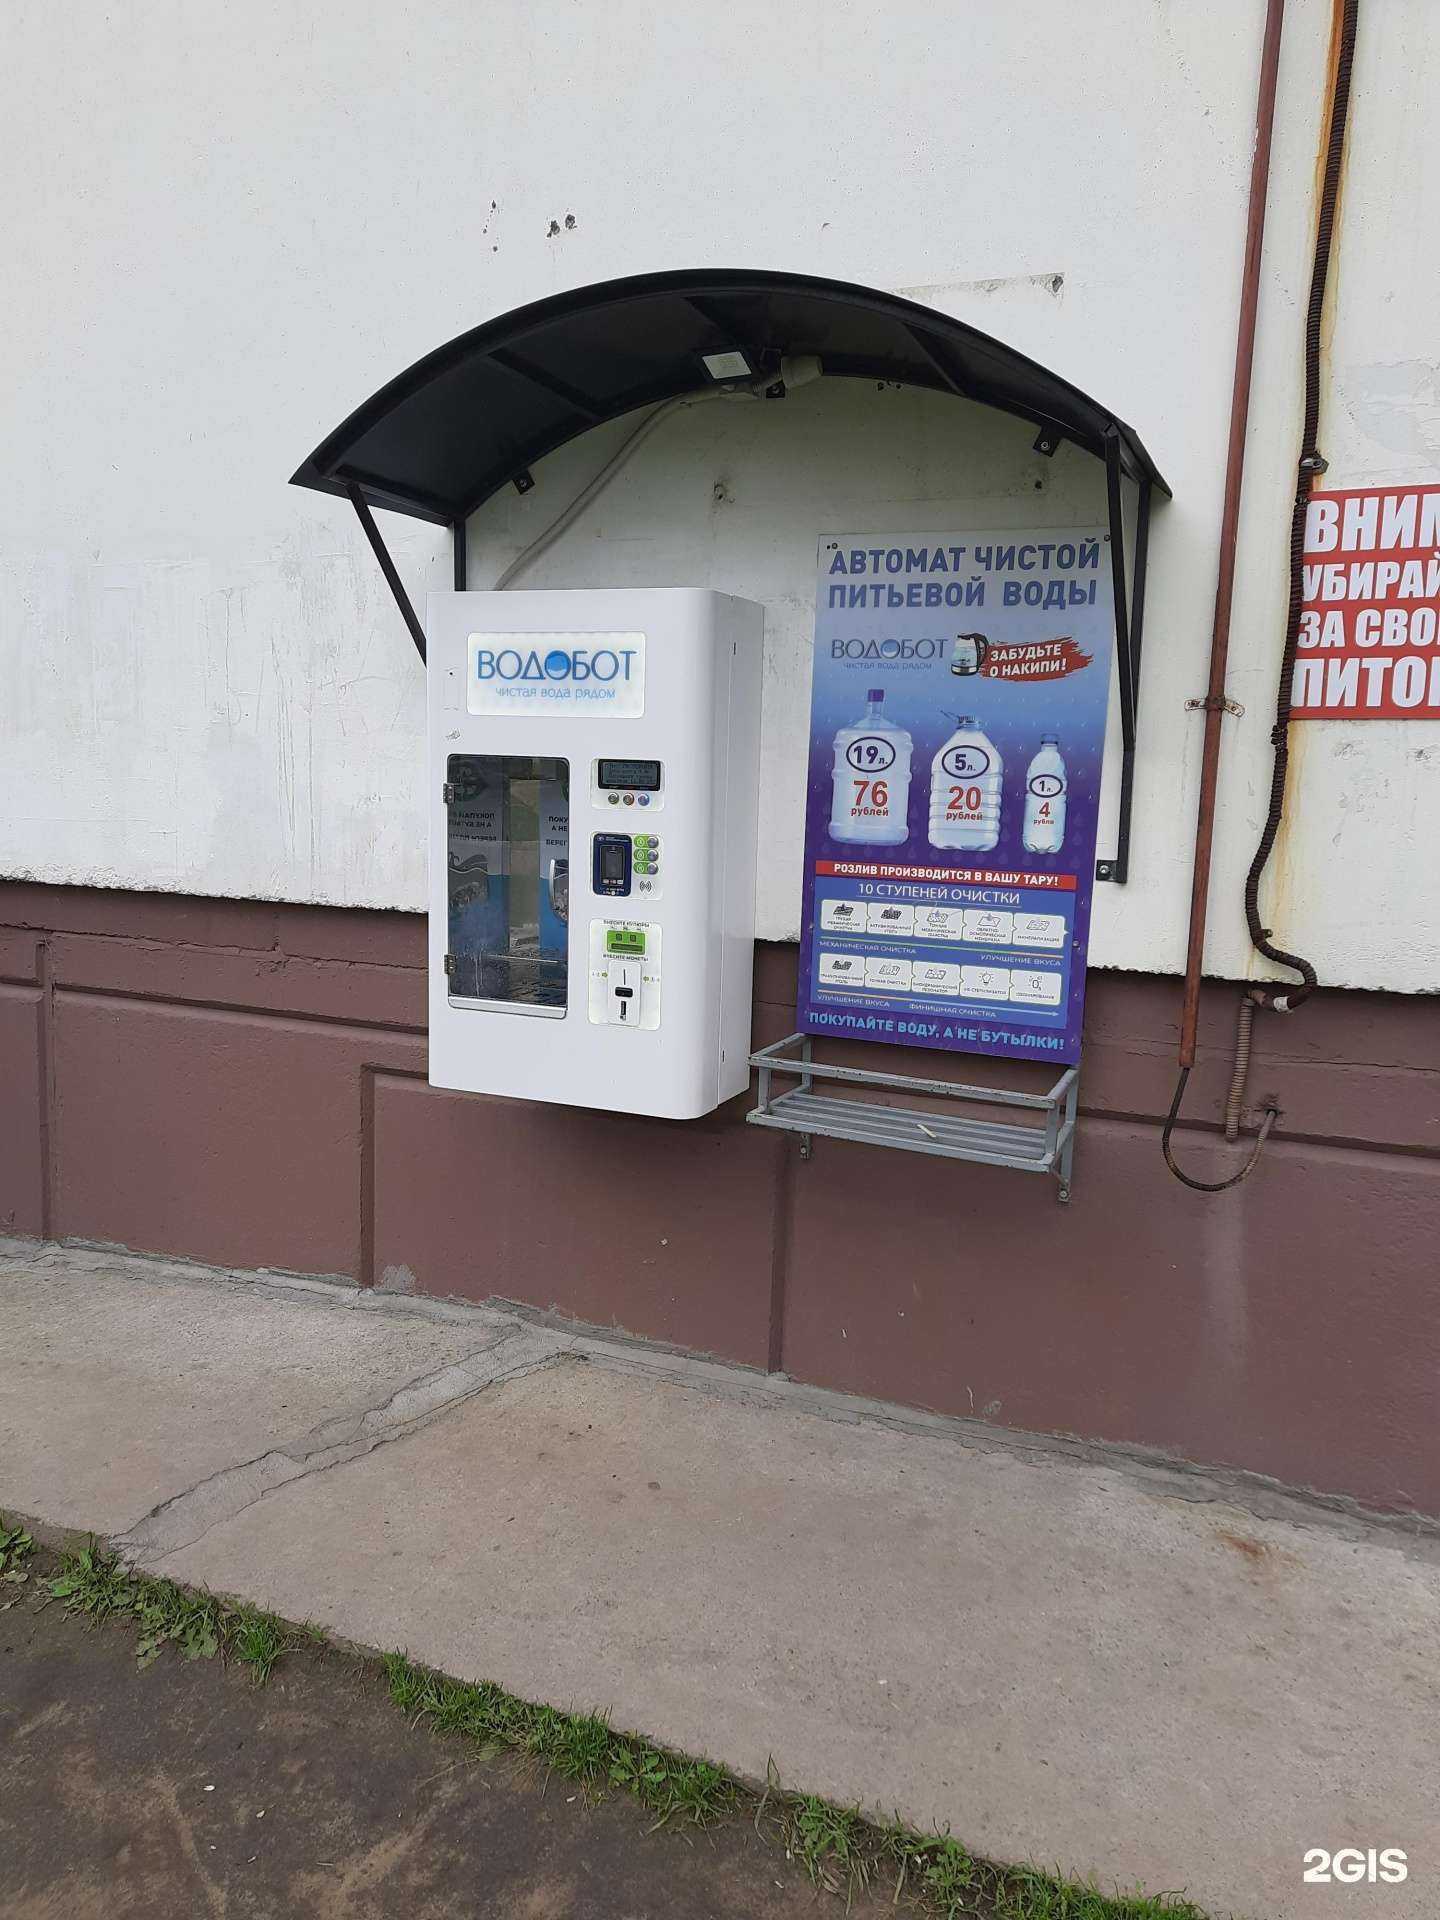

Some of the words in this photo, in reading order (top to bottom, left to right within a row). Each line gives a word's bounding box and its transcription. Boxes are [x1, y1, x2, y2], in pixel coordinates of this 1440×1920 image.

[829, 547, 966, 575] АВТОМАТ
[975, 537, 1099, 571] ЧИСТОЙ
[829, 576, 986, 608] ПИТЬЕВОЙ
[1003, 579, 1096, 610] ВОДЫ
[1298, 610, 1345, 648] ЗА
[1356, 607, 1440, 647] СВО
[832, 639, 949, 660] ВОДОБОТ
[990, 644, 1062, 661] ЗАБУДЬТЕ
[477, 650, 637, 681] ВОДОБОТ
[989, 666, 999, 677] О
[1001, 658, 1067, 676] НАКИПИ!
[1291, 656, 1440, 708] ПИТО
[496, 687, 536, 697] чистая
[541, 687, 571, 699] вода
[575, 688, 616, 702] рядом
[853, 780, 888, 807] 76
[948, 786, 982, 811] 20
[850, 806, 889, 818] рублей
[945, 810, 983, 822] рублей
[1039, 801, 1051, 817] 4
[834, 863, 877, 875] РОЗЛИВ
[880, 866, 971, 880] ПРОИЗВОДИТСЯ
[974, 871, 982, 881] В
[985, 872, 1021, 884] ВАШУ
[1024, 874, 1059, 886] ТАРУ!
[859, 883, 873, 895] 10
[876, 884, 948, 899] СТУПЕНЕЙ
[951, 889, 1020, 904] ОЧИСТКИ
[819, 941, 879, 952] МЕХАНИЧЕСКАЯ
[880, 945, 916, 955] ОЧИСТКА
[980, 954, 1031, 965] УЛУЧШЕНИЕ
[1033, 958, 1061, 967] ВКУСА
[817, 994, 863, 1005] УЛУЧШЕНИЕ
[865, 999, 890, 1008] ВКУСА
[910, 1003, 958, 1013] ФИНИШНАЯ
[959, 1008, 997, 1018] ОЧИСТКА
[809, 1012, 894, 1032] ПОКУПАЙТЕ
[897, 1021, 940, 1038] ВОДУ,
[943, 1027, 954, 1038] А
[957, 1028, 977, 1040] НЕ
[981, 1030, 1065, 1049] БУТЫЛКИ!
